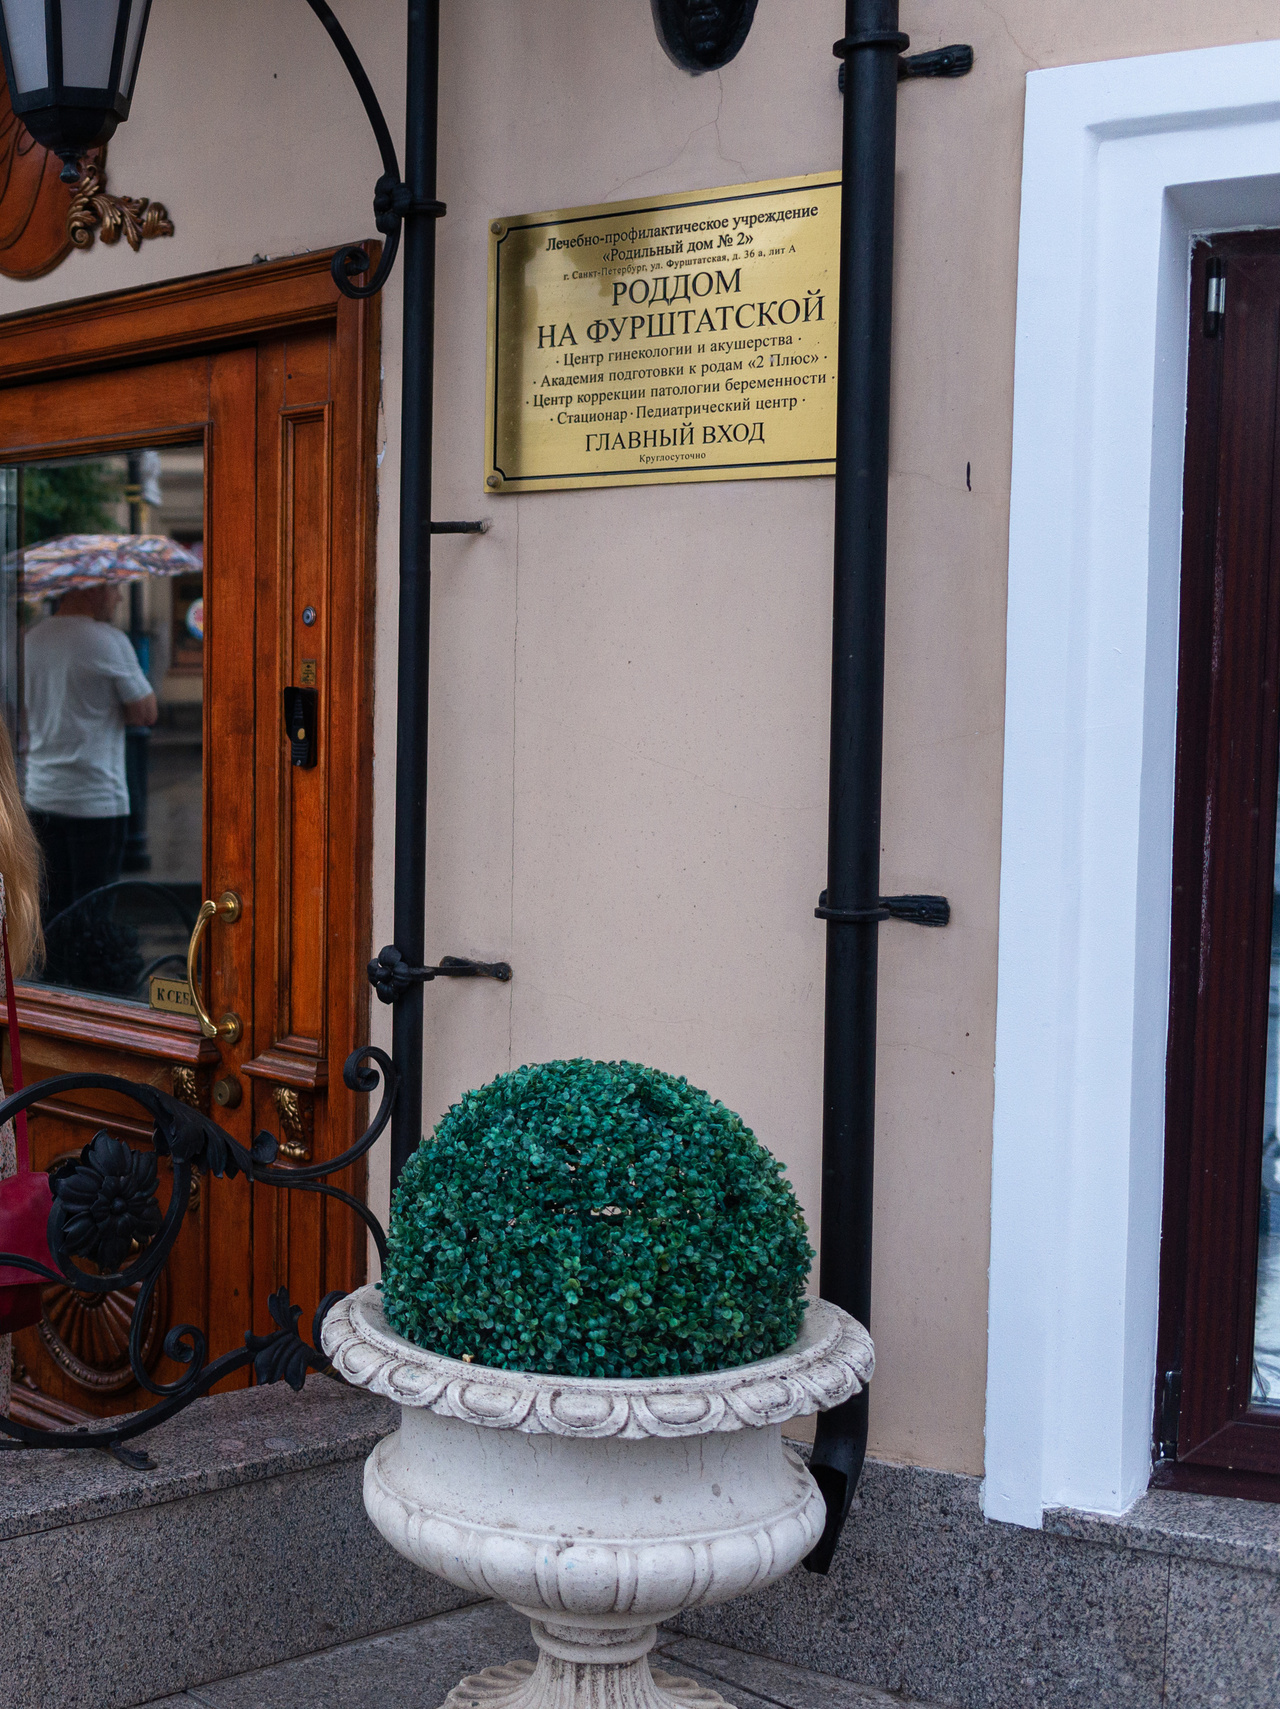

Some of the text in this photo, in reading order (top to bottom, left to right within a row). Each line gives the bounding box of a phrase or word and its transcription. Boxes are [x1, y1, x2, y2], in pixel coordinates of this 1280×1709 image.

[546, 206, 819, 251] Лечебно-профилактическое учреждение
[563, 273, 570, 281] г.
[571, 263, 648, 280] Санкт-Петербург,
[650, 261, 663, 271] ул.
[666, 255, 730, 270] Фурштатская,
[732, 253, 741, 261] д.
[744, 250, 755, 259] 36
[768, 247, 786, 256] лит
[788, 244, 797, 254] А
[602, 240, 683, 262] «Родильный
[686, 240, 714, 254] дом
[736, 232, 754, 246] 2»
[612, 268, 742, 308] РОДДОМ
[537, 288, 826, 349] НА ФУРШТАТСКОЙ
[564, 335, 793, 367] Центр гинекологии и акушерства
[540, 353, 819, 388] Академия подготовки к родам «2 Плюс»
[533, 373, 827, 409] Центр коррекции патологии беременности
[557, 397, 798, 425] Стационар Педиатрический центр
[585, 422, 766, 452] ГЛАВНЫЙ ВХОД
[639, 453, 706, 464] Круглосуточно
[157, 987, 166, 1002] К
